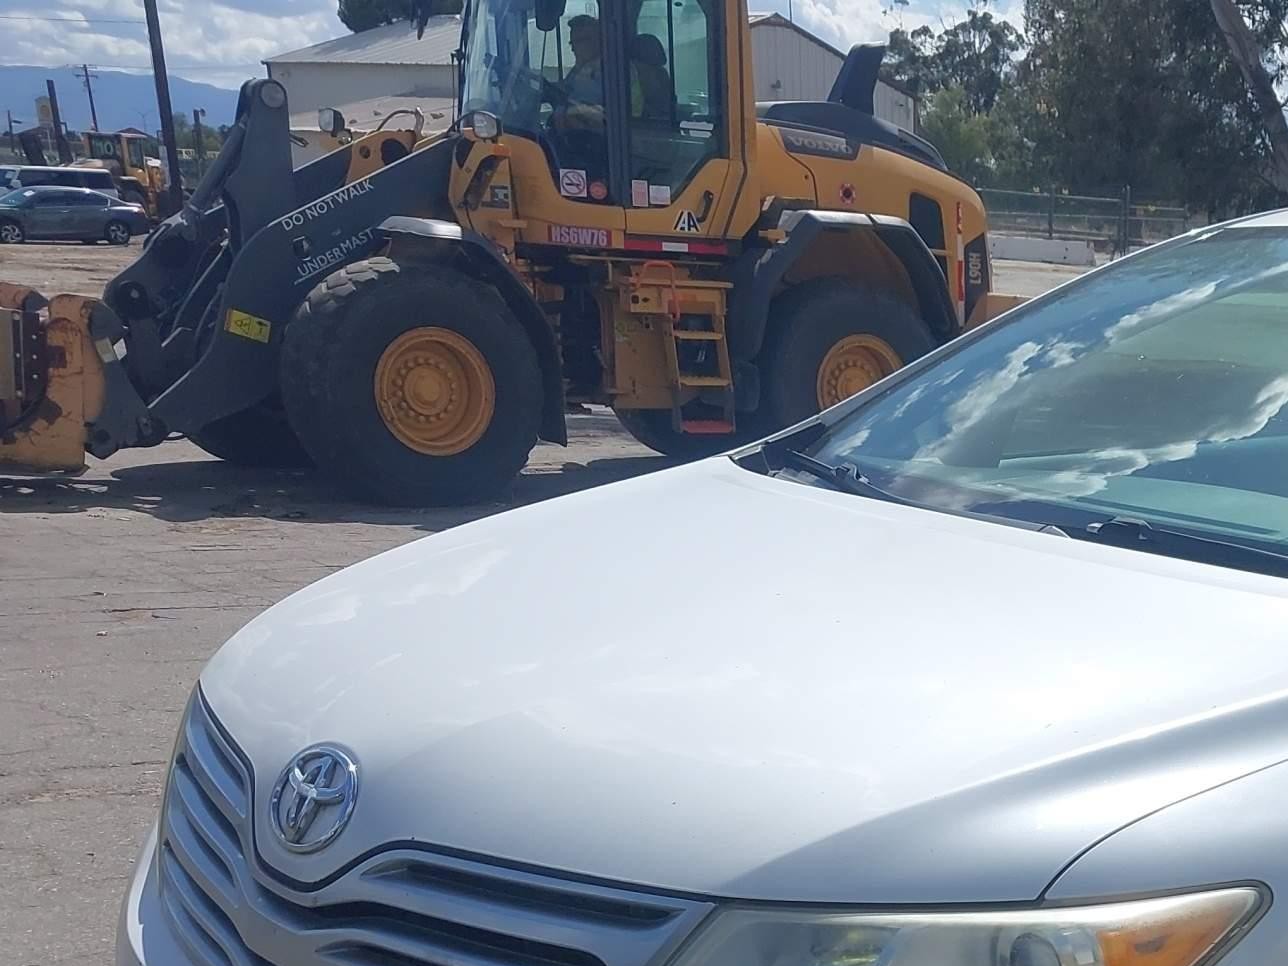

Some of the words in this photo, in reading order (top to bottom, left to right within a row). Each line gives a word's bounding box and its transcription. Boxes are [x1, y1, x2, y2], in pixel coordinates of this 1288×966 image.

[787, 135, 854, 154] VOLVO
[281, 213, 304, 231] DO
[305, 197, 335, 220] NOT
[334, 179, 375, 204] WALK
[296, 247, 343, 276] UNDER
[340, 228, 375, 253] MAST
[968, 252, 981, 284] L90H
